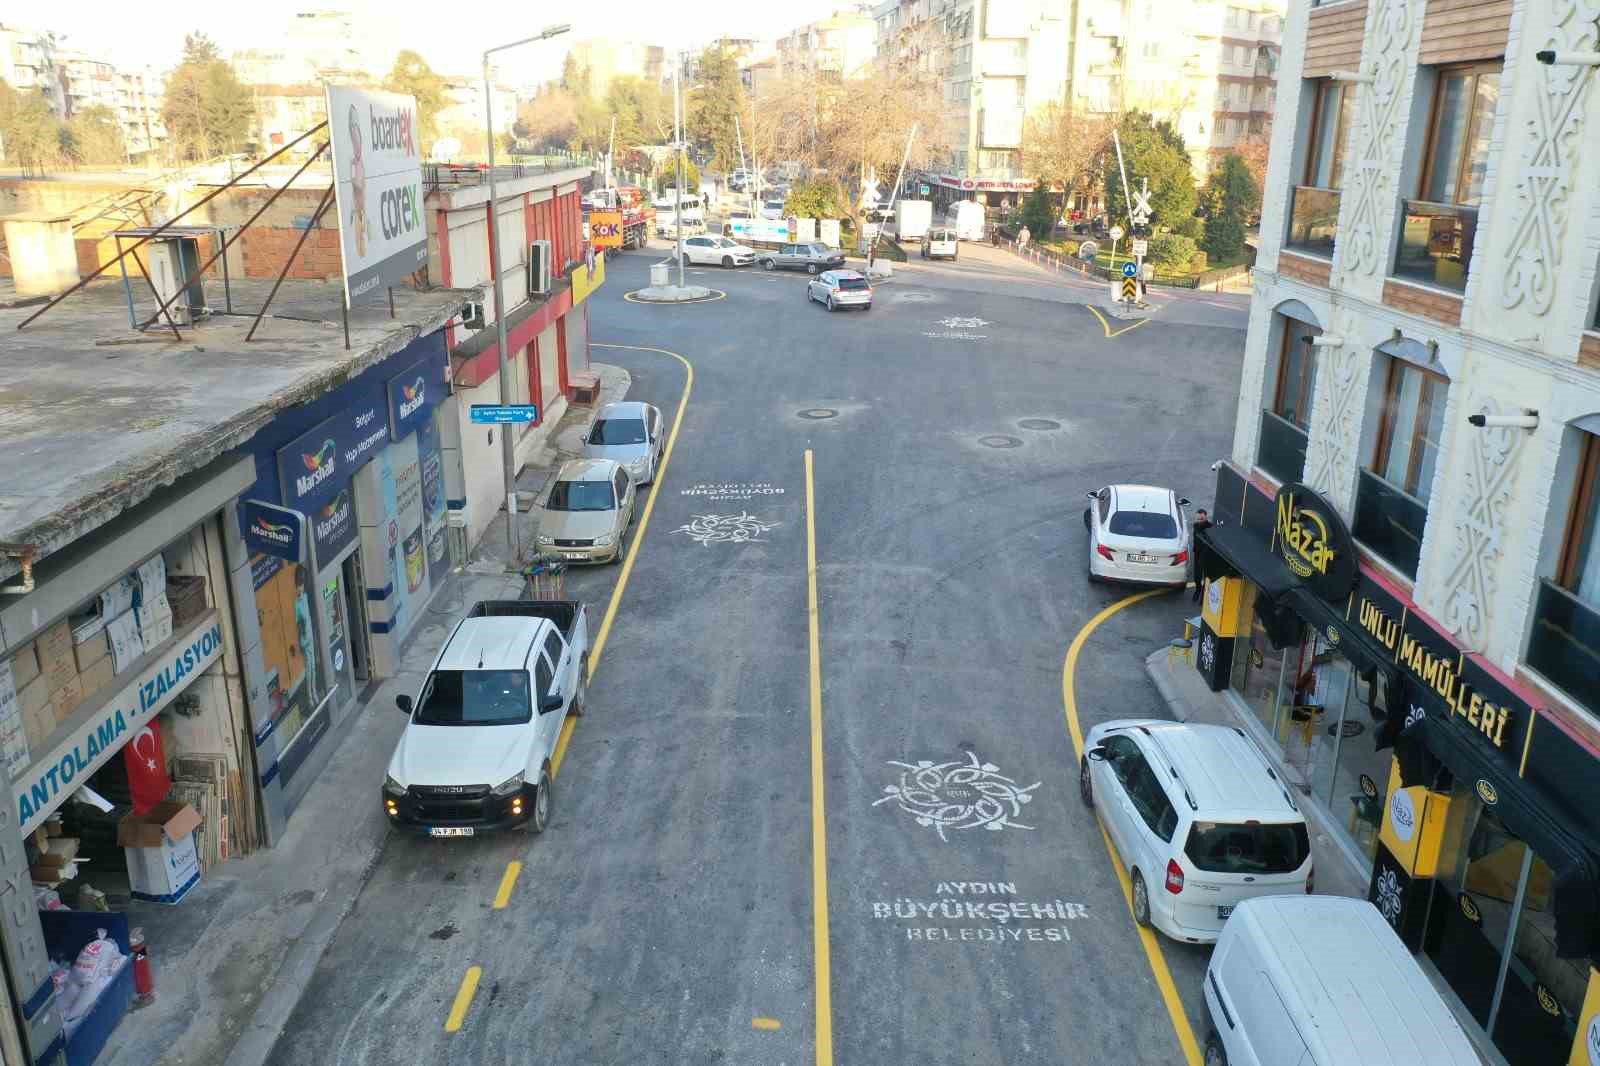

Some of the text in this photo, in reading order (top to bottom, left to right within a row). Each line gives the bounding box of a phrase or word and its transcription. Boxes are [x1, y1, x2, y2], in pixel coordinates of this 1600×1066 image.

[369, 104, 415, 157] boardex
[380, 184, 419, 241] corex
[399, 390, 425, 419] Marshall
[296, 456, 335, 497] Marshall
[250, 524, 290, 543] Marshall
[317, 503, 349, 541] Marshall
[1277, 492, 1334, 574] Nazar
[138, 623, 223, 713] İZALASYON
[935, 881, 1018, 895] AYDIN
[872, 898, 1090, 924] BÜYÜKŞEHİR
[906, 926, 1073, 942] BELEDİYESİ
